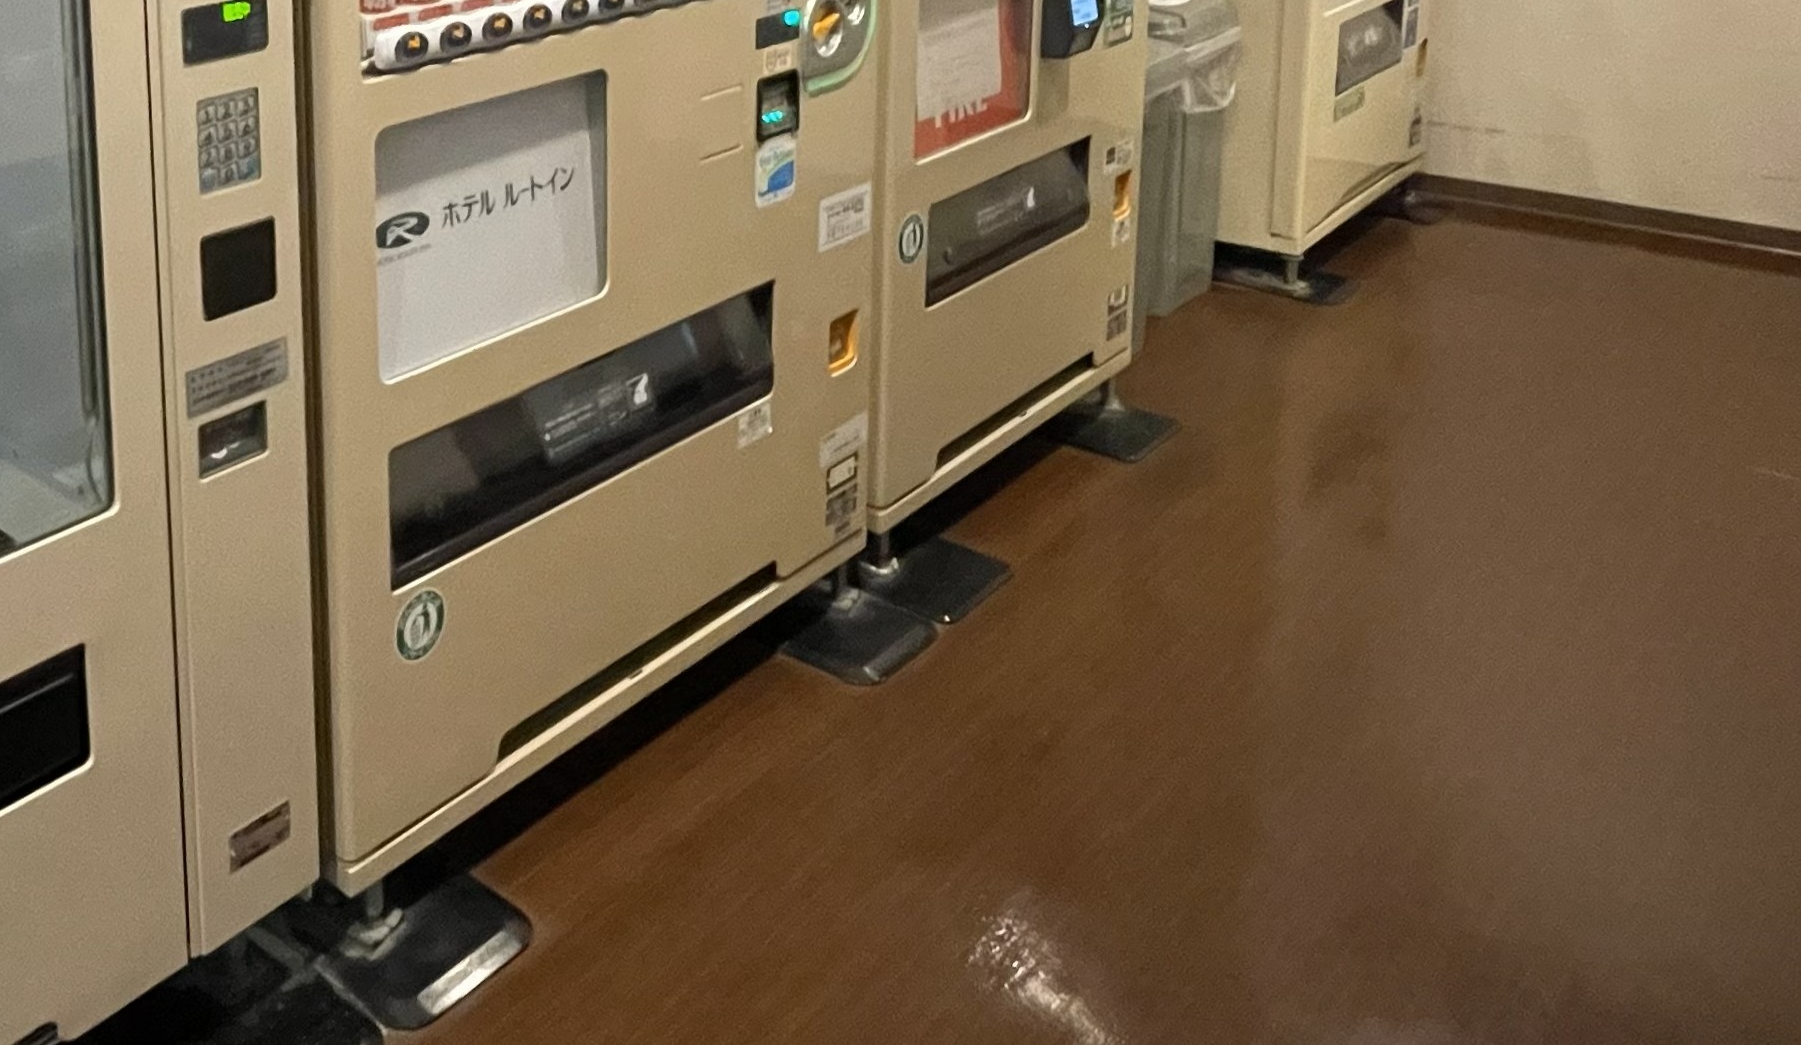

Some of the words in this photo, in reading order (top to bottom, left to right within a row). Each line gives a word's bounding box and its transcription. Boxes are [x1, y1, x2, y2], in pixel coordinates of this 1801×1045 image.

[441, 190, 496, 229] ホテル
[503, 167, 576, 210] ルートイン
